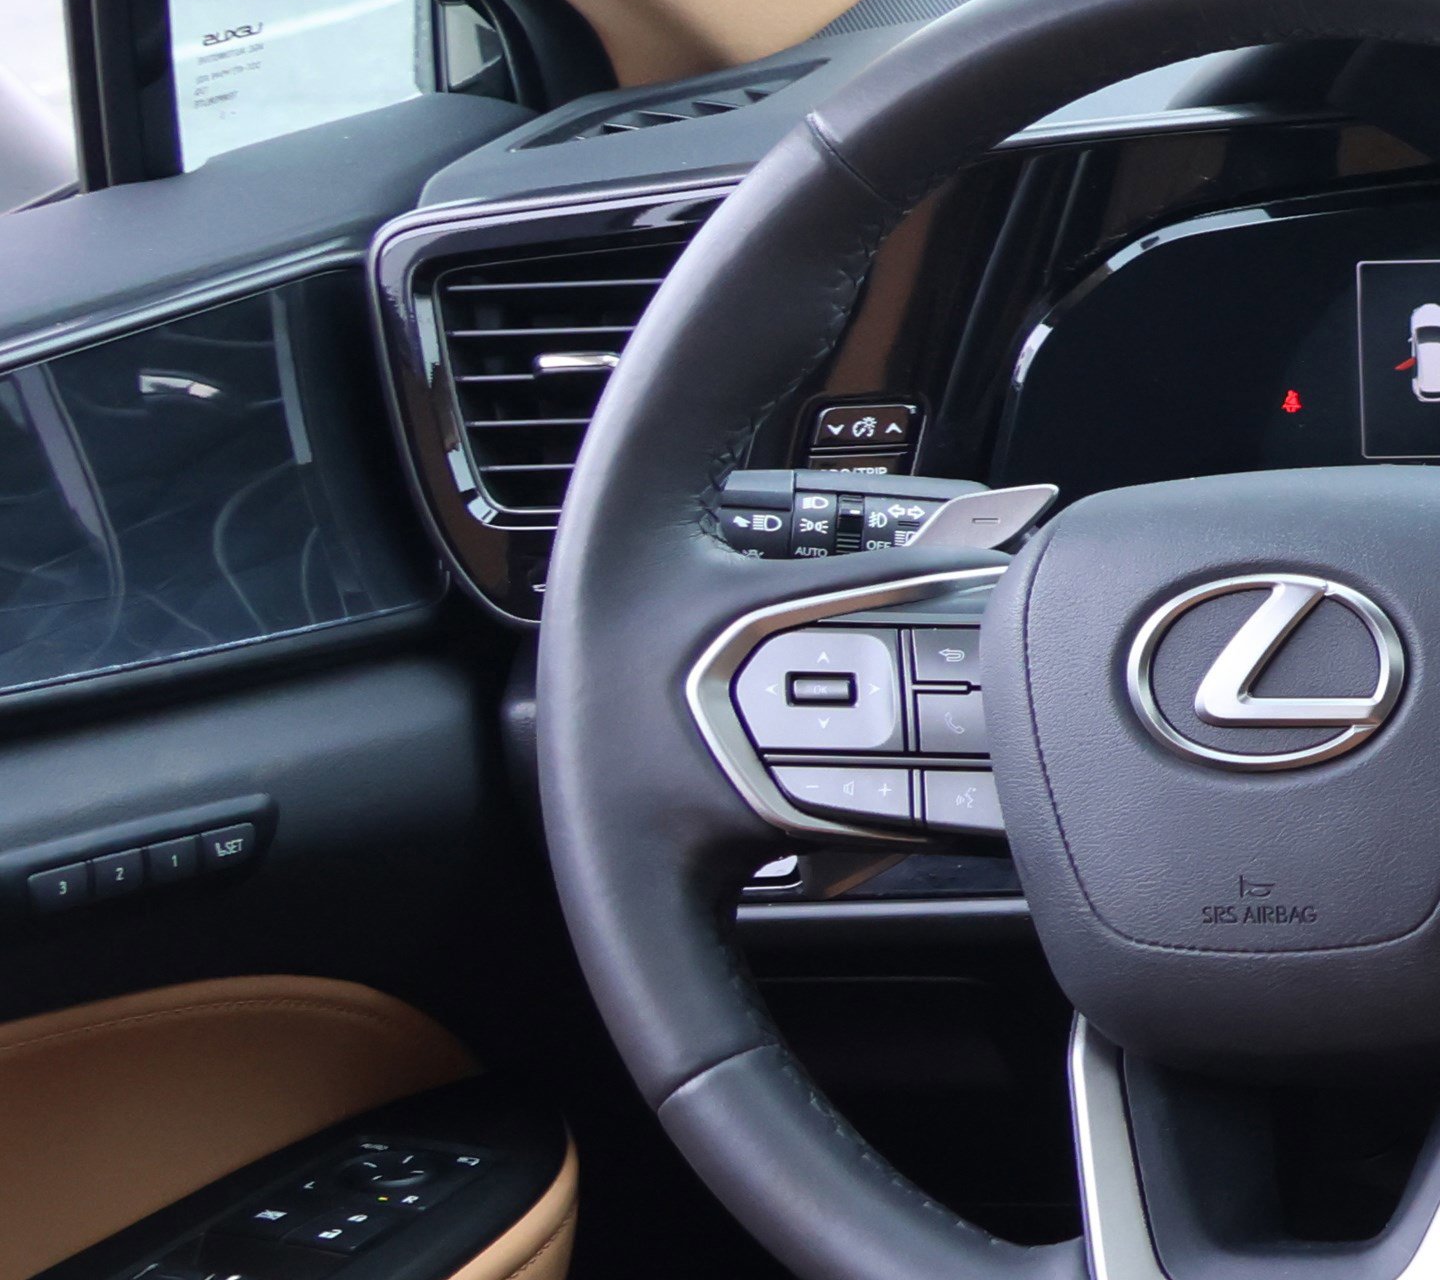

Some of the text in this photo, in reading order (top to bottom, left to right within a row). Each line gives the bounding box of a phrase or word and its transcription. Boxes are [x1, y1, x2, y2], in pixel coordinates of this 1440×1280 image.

[866, 540, 892, 551] OFF
[794, 547, 828, 558] AUTO
[172, 854, 179, 867] 1
[116, 867, 124, 881] 2
[59, 881, 67, 895] 3
[1202, 906, 1318, 924] SRS AIRBAG
